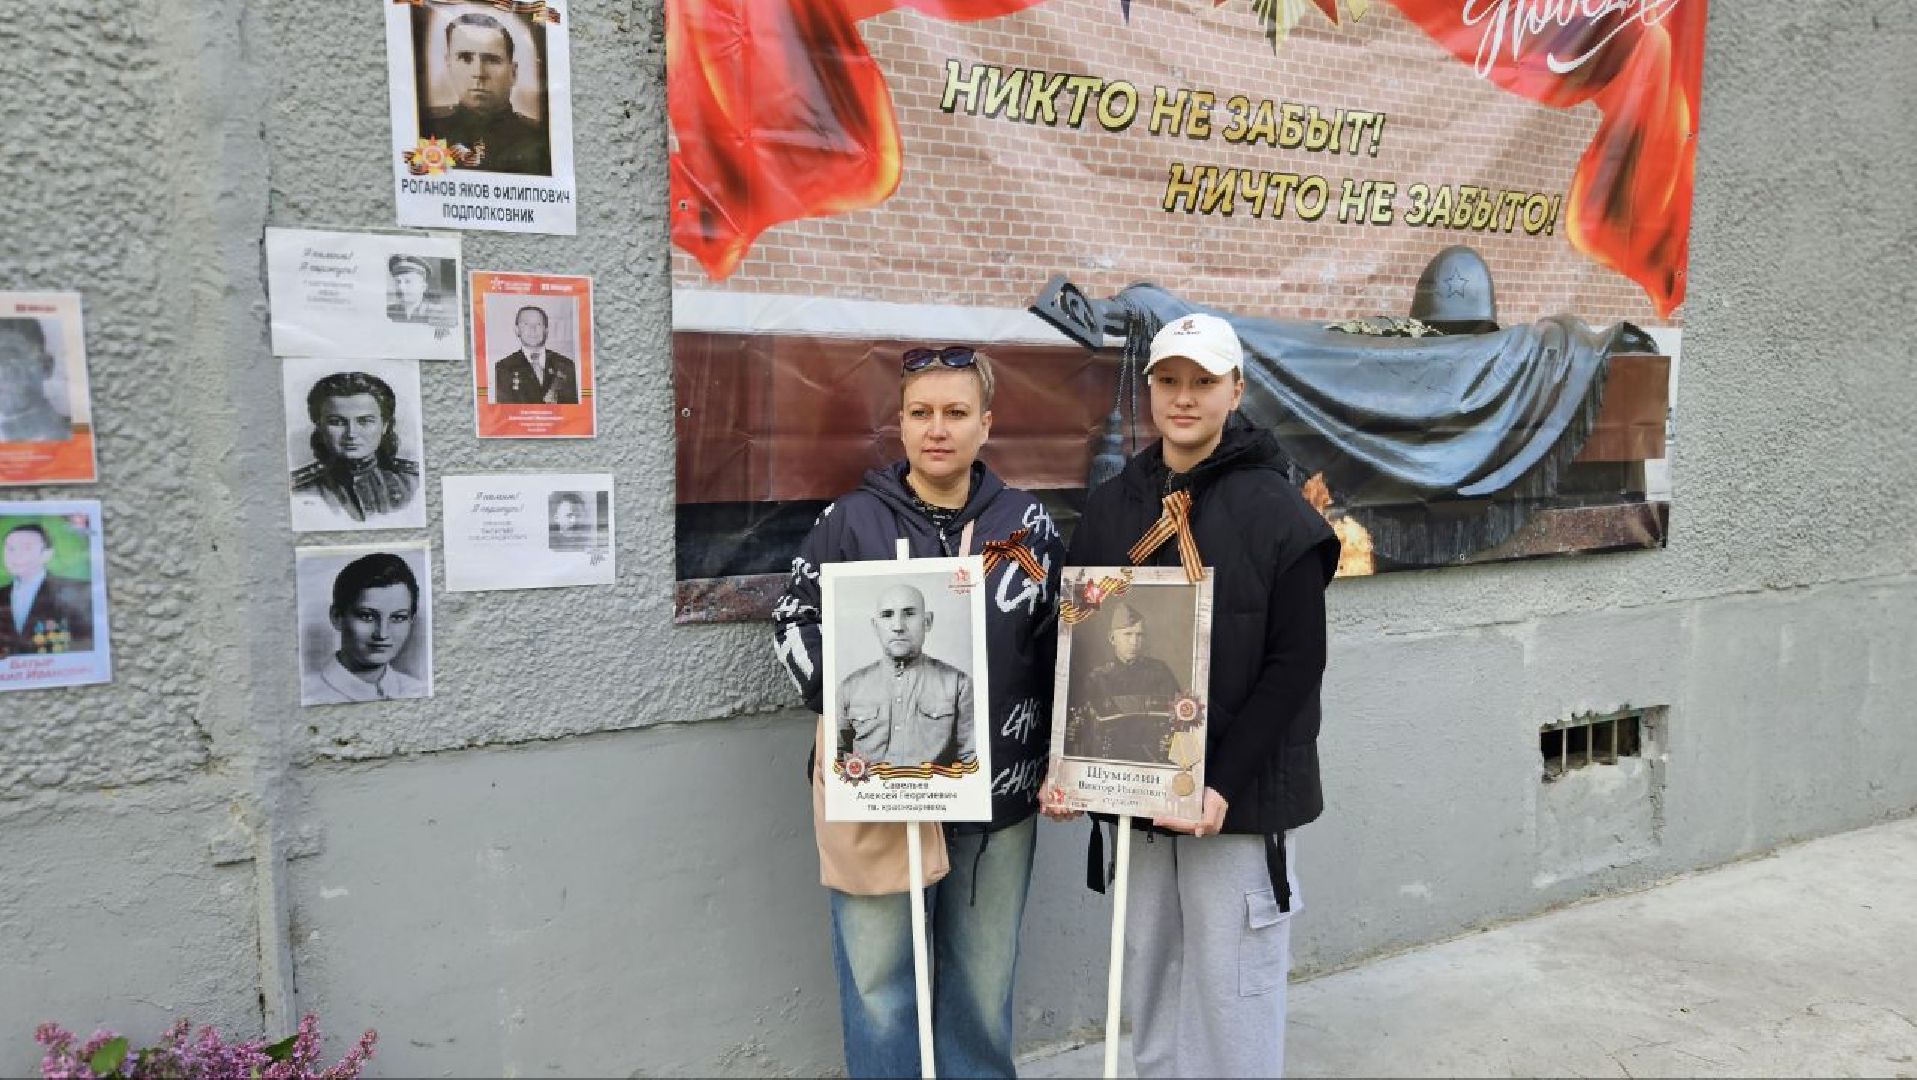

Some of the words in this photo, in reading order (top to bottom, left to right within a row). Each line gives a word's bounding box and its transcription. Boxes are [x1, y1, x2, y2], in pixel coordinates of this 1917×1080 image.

[940, 58, 1139, 133] НИКТО
[1148, 85, 1216, 141] НЕ
[1221, 95, 1387, 158] ЗАБЫТ!
[401, 178, 456, 197] РОГАНОВ
[458, 183, 490, 199] ЯКОВ
[493, 186, 570, 204] ФИЛИППОВИЧ
[1162, 162, 1330, 221] НИЧТО
[1337, 178, 1396, 227] НЕ
[1403, 183, 1562, 236] ЗАБЫТО!
[442, 203, 535, 224] ПОДПОЛКОВНИК
[882, 780, 929, 790] Савельев
[1087, 765, 1161, 785] Шумилин
[857, 790, 898, 800] Алексей
[899, 790, 958, 802] Георгиевич
[1078, 780, 1115, 795] Виктор
